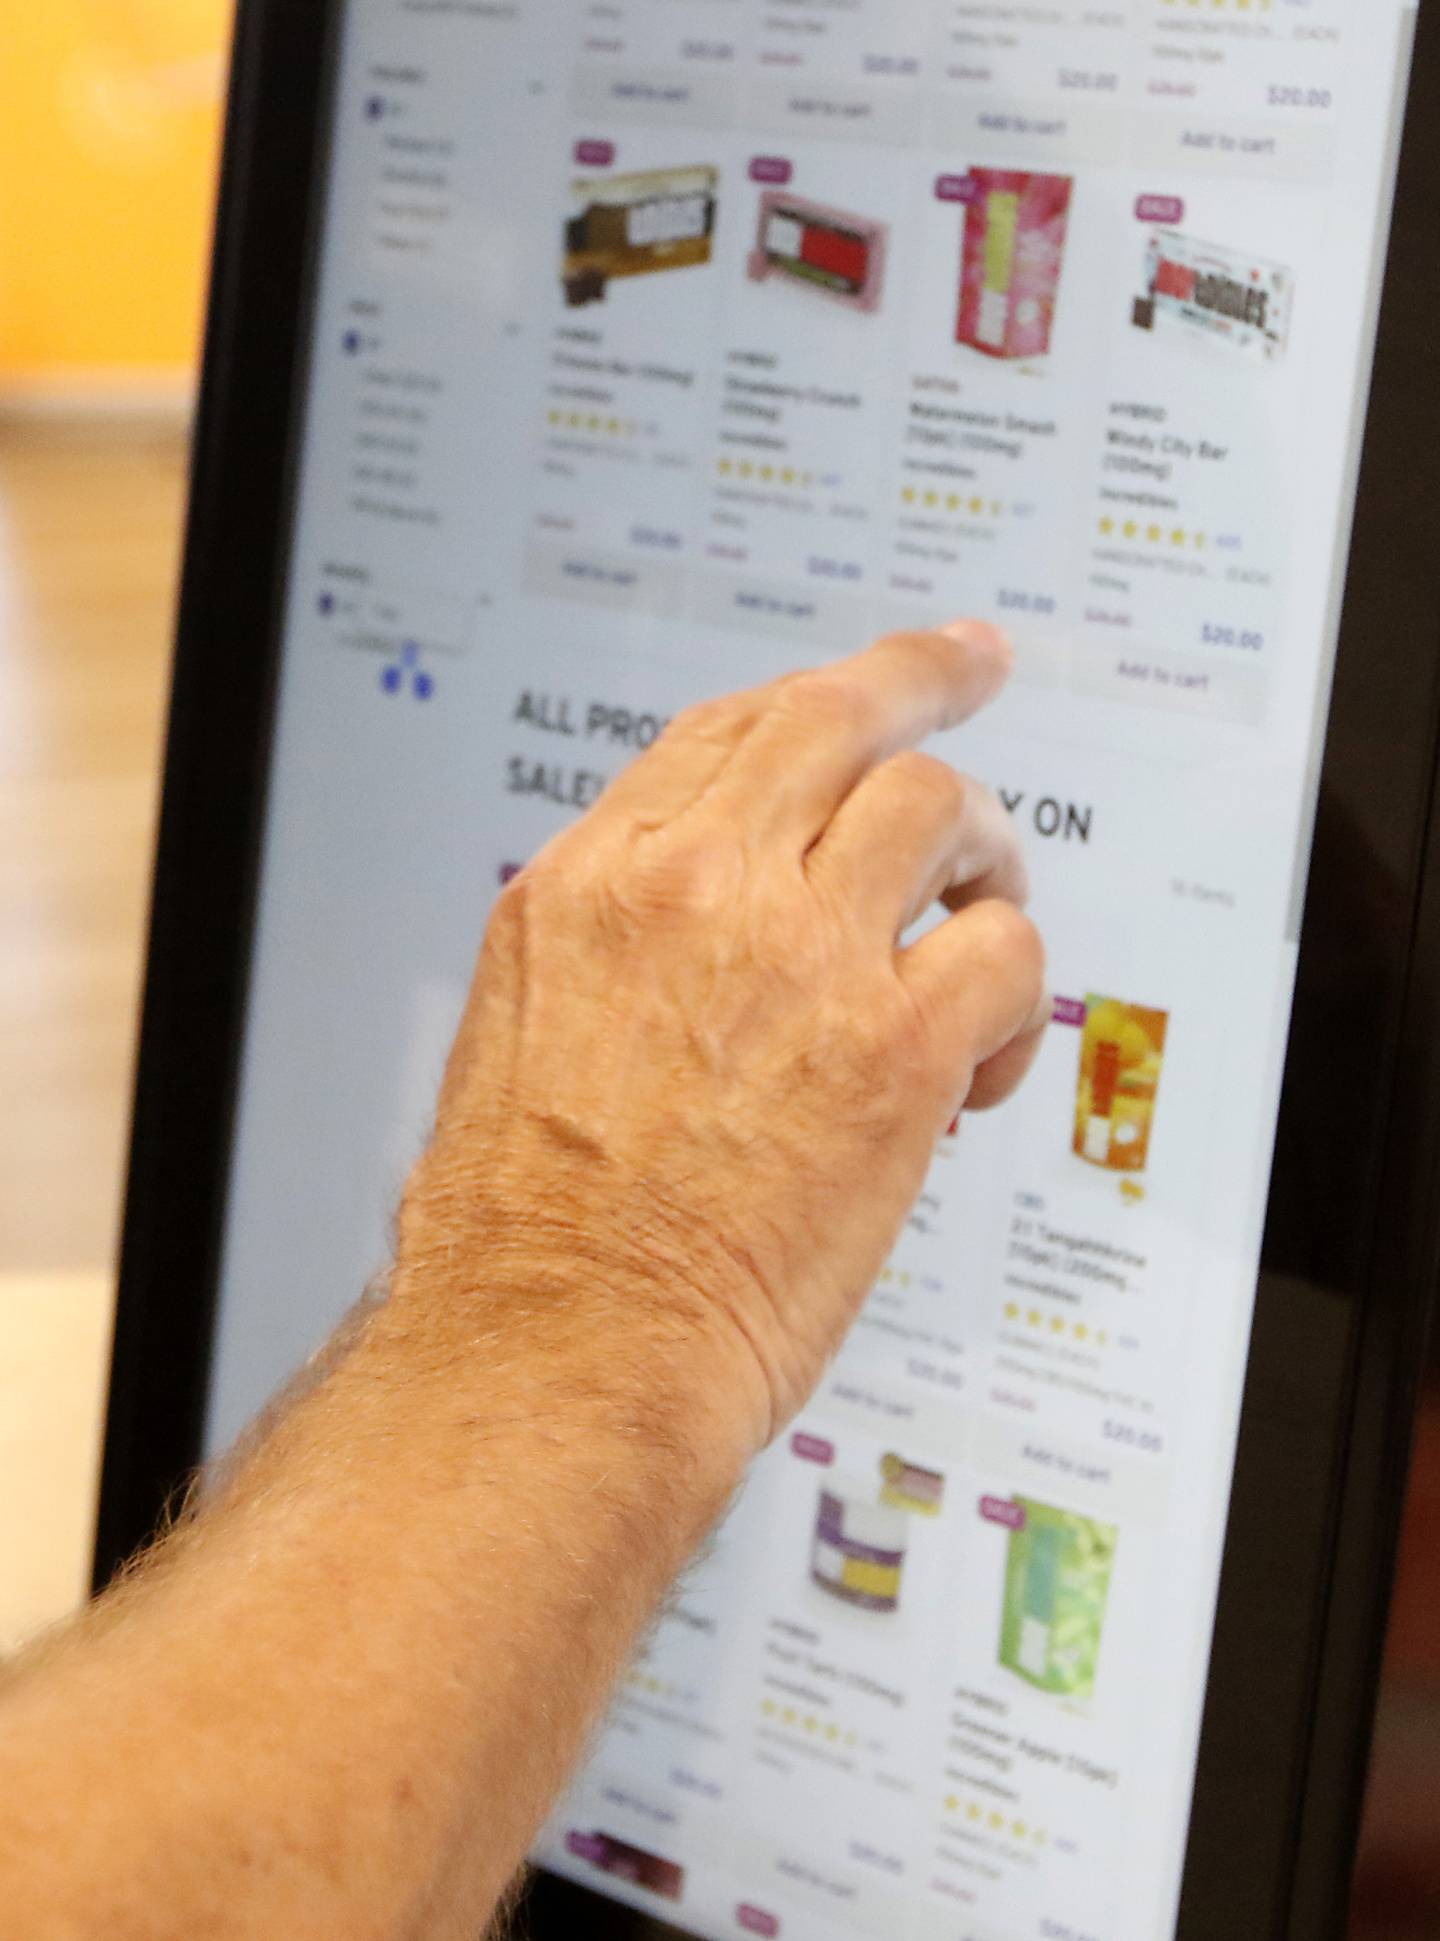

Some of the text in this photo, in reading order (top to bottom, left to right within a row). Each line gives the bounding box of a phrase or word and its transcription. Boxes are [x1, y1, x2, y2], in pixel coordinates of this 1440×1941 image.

[1266, 84, 1332, 109] $20.00
[978, 112, 1067, 135] Add to cart
[1181, 130, 1276, 155] Add to cart
[1107, 427, 1228, 462] Windy City Bar
[1201, 622, 1264, 651] $20.00
[1117, 660, 1210, 691] Add to cart
[513, 689, 671, 751] ALL PRO
[1034, 797, 1092, 844] ON
